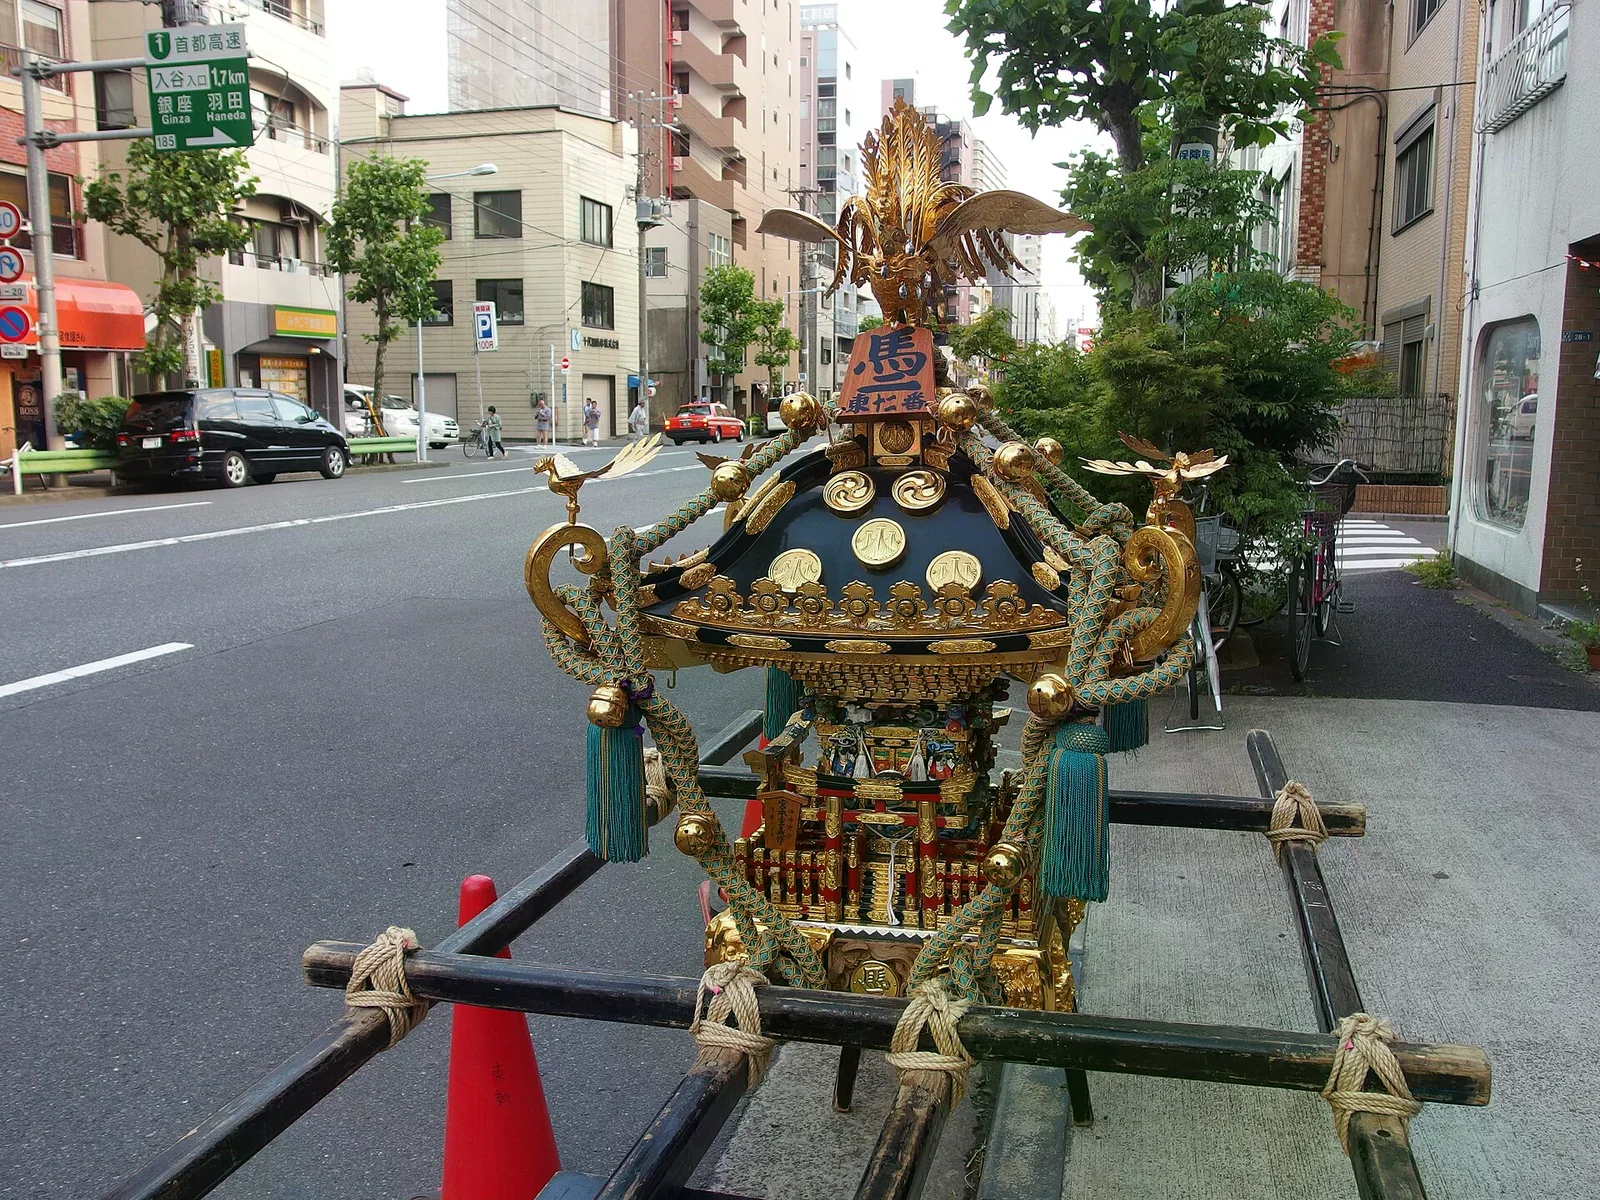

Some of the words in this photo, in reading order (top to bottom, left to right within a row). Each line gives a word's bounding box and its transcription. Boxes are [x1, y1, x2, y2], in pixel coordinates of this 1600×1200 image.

[174, 31, 242, 54] 首都高速
[211, 67, 246, 87] 1.7km
[157, 94, 193, 114] 銀座
[207, 91, 243, 111] 羽田
[161, 114, 191, 125] Ginza
[206, 110, 247, 122] Haneda
[157, 136, 175, 148] 185
[477, 315, 491, 338] P
[1574, 333, 1590, 342] 28-1
[19, 406, 39, 415] BOSS
